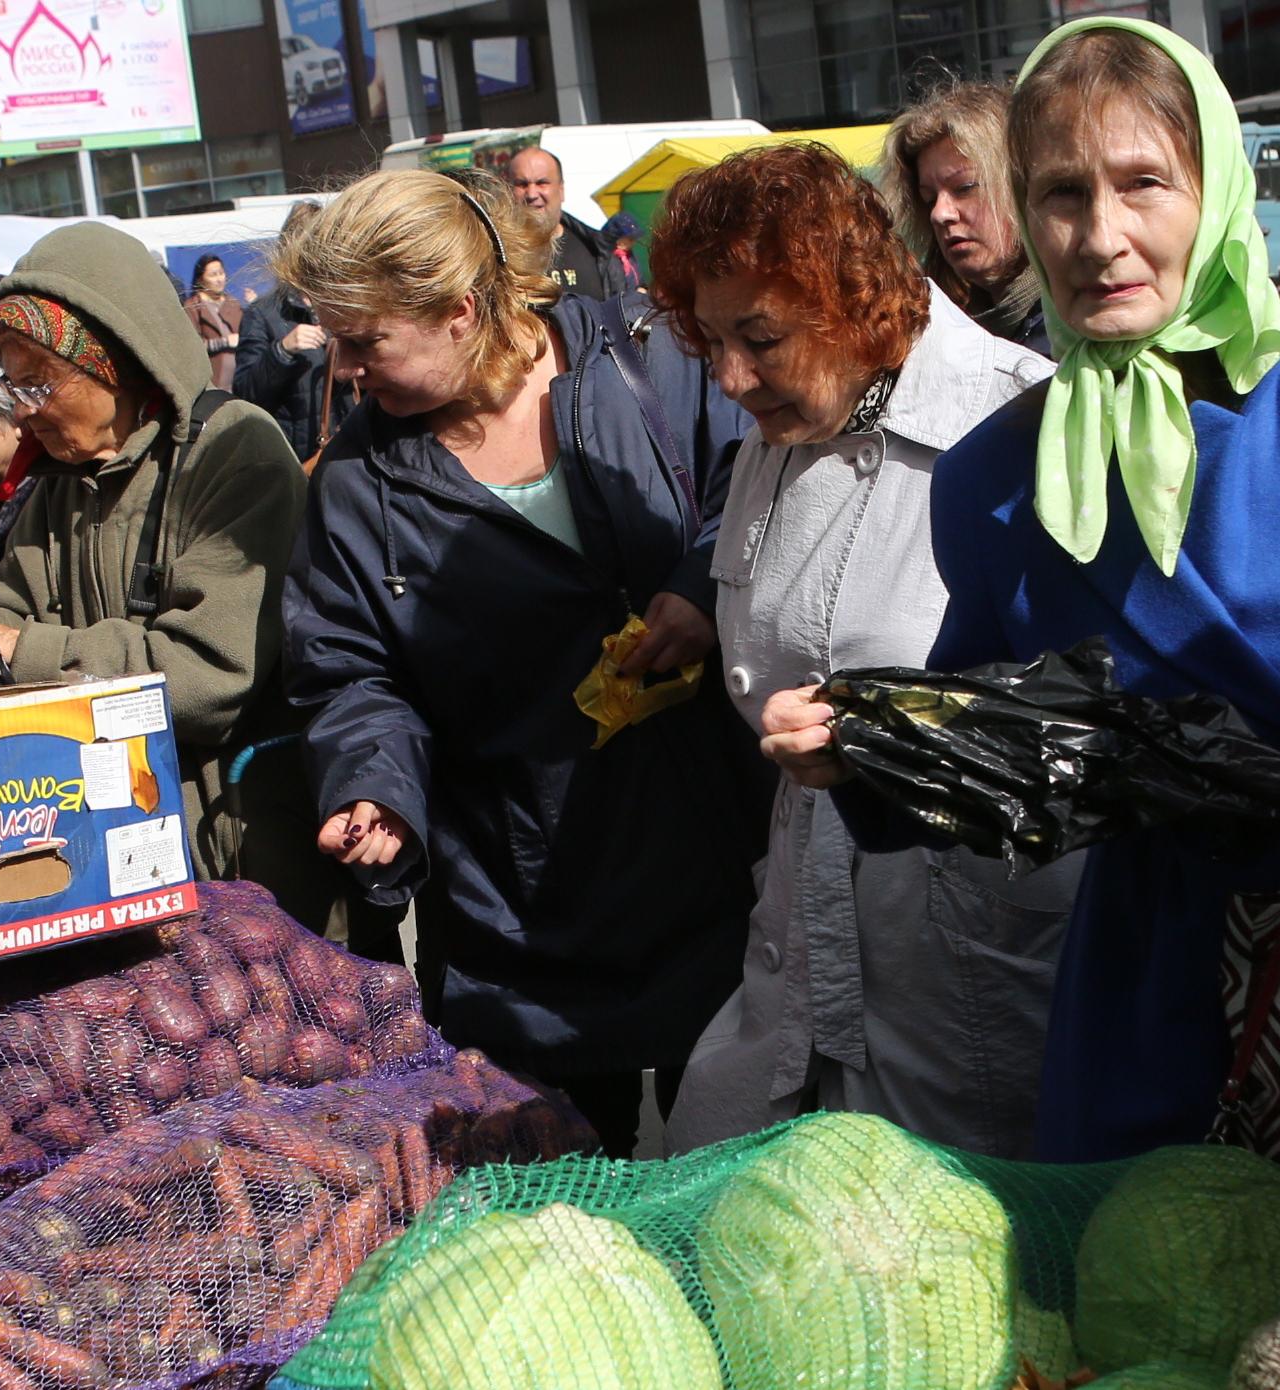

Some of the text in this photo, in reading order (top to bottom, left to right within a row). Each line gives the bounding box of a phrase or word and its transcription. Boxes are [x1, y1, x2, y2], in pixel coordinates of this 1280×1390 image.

[19, 44, 75, 60] МИСС
[22, 61, 77, 77] РОССИЯ
[111, 891, 185, 926] EXTRA
